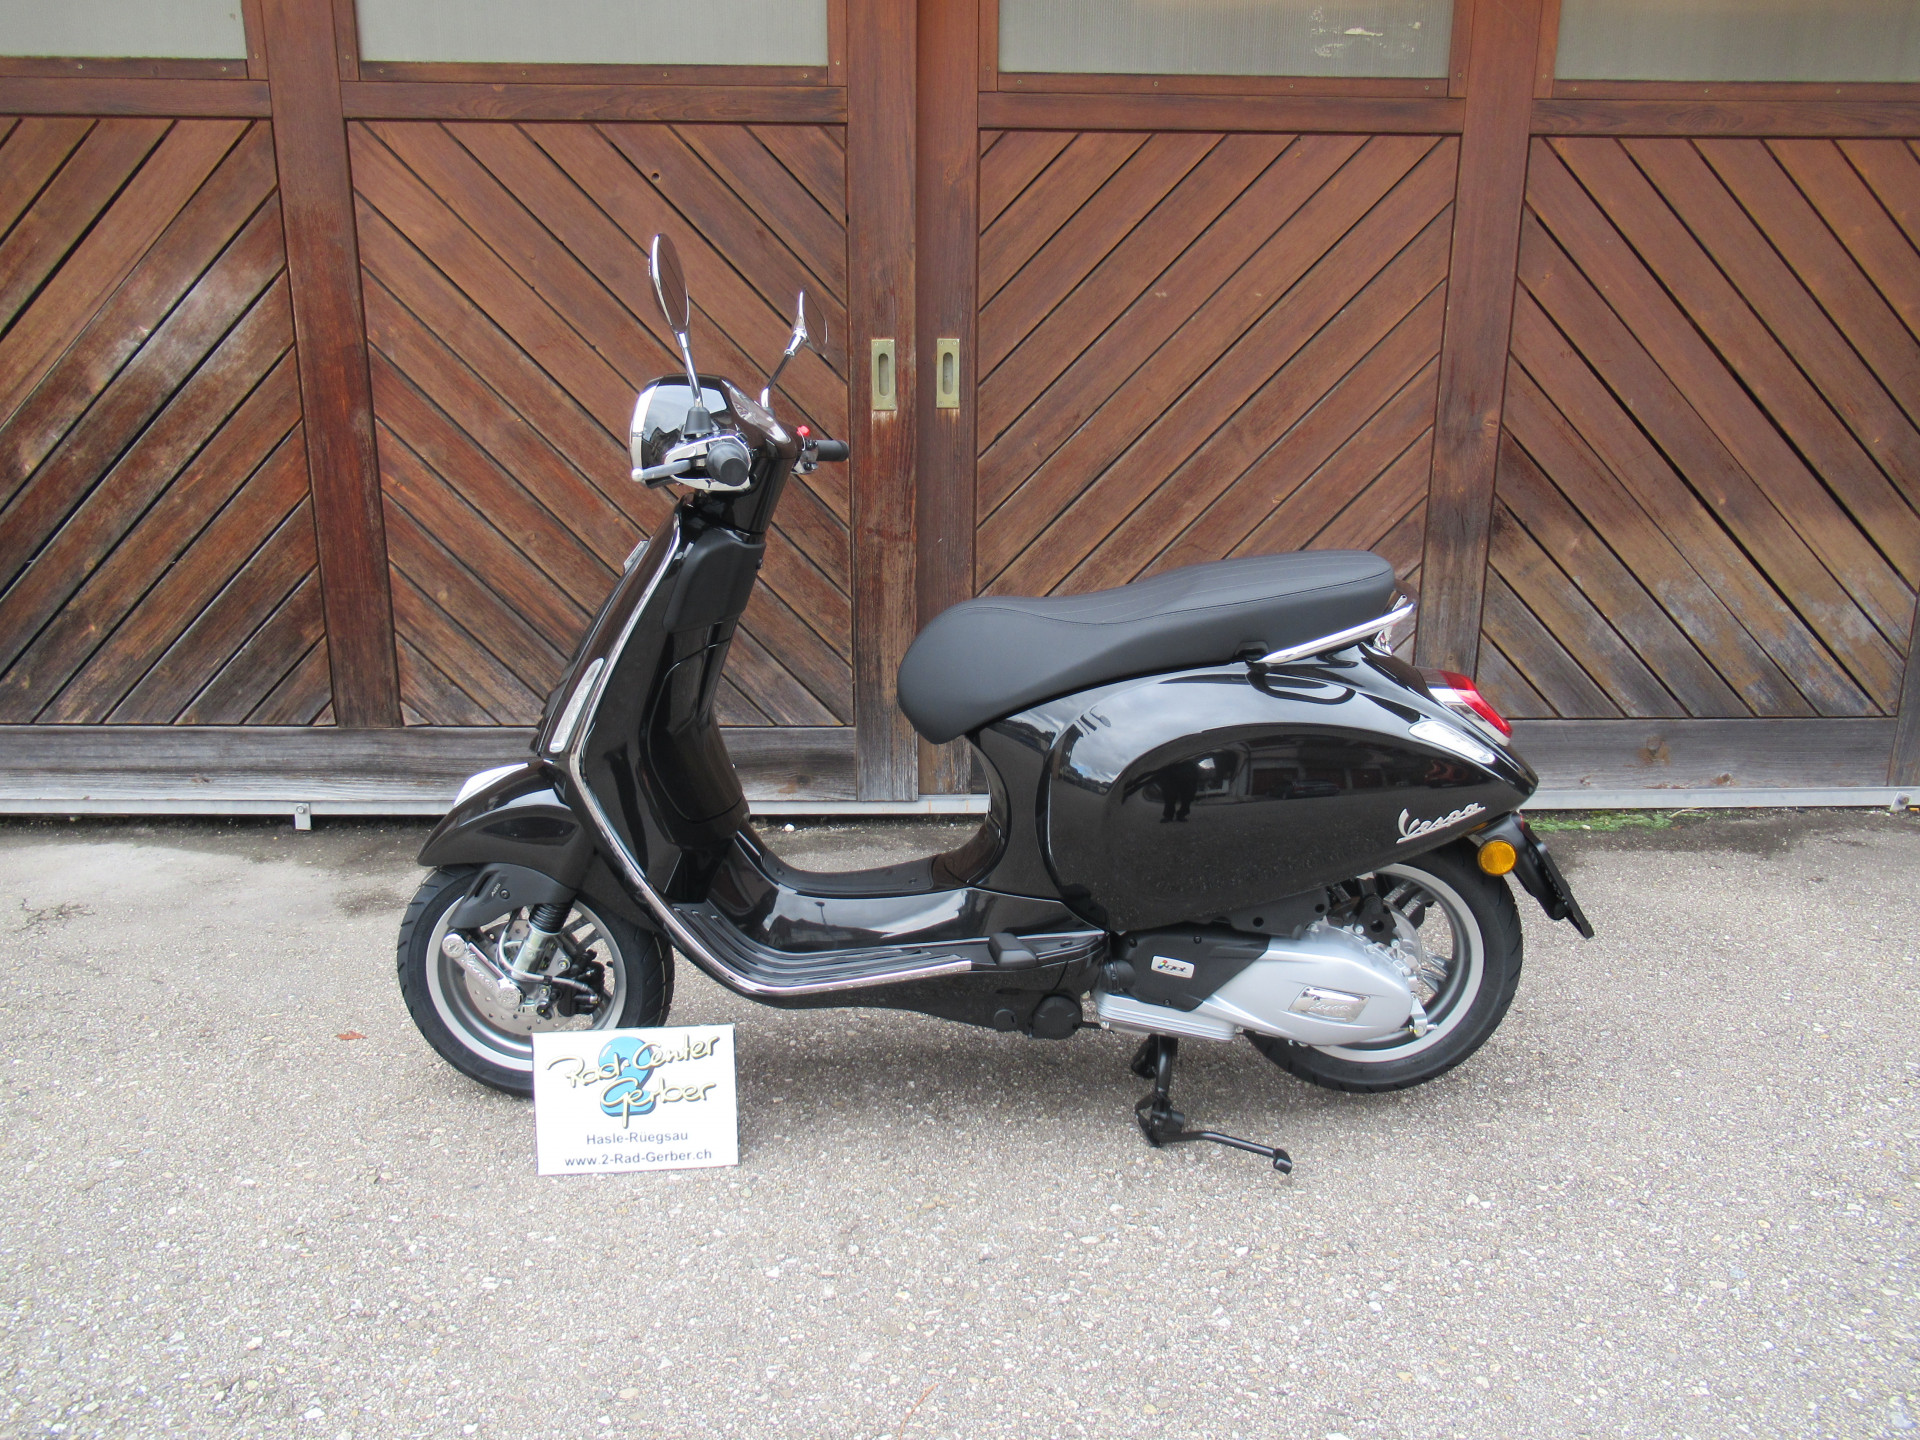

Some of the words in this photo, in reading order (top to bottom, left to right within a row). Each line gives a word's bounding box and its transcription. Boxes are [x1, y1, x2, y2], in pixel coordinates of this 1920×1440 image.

[1396, 803, 1486, 844] Vespa
[600, 1077, 717, 1129] Gerber
[586, 1132, 689, 1146] Hasle-Rüegsau
[564, 1149, 712, 1167] www.2-Rad-Gerber.ch
